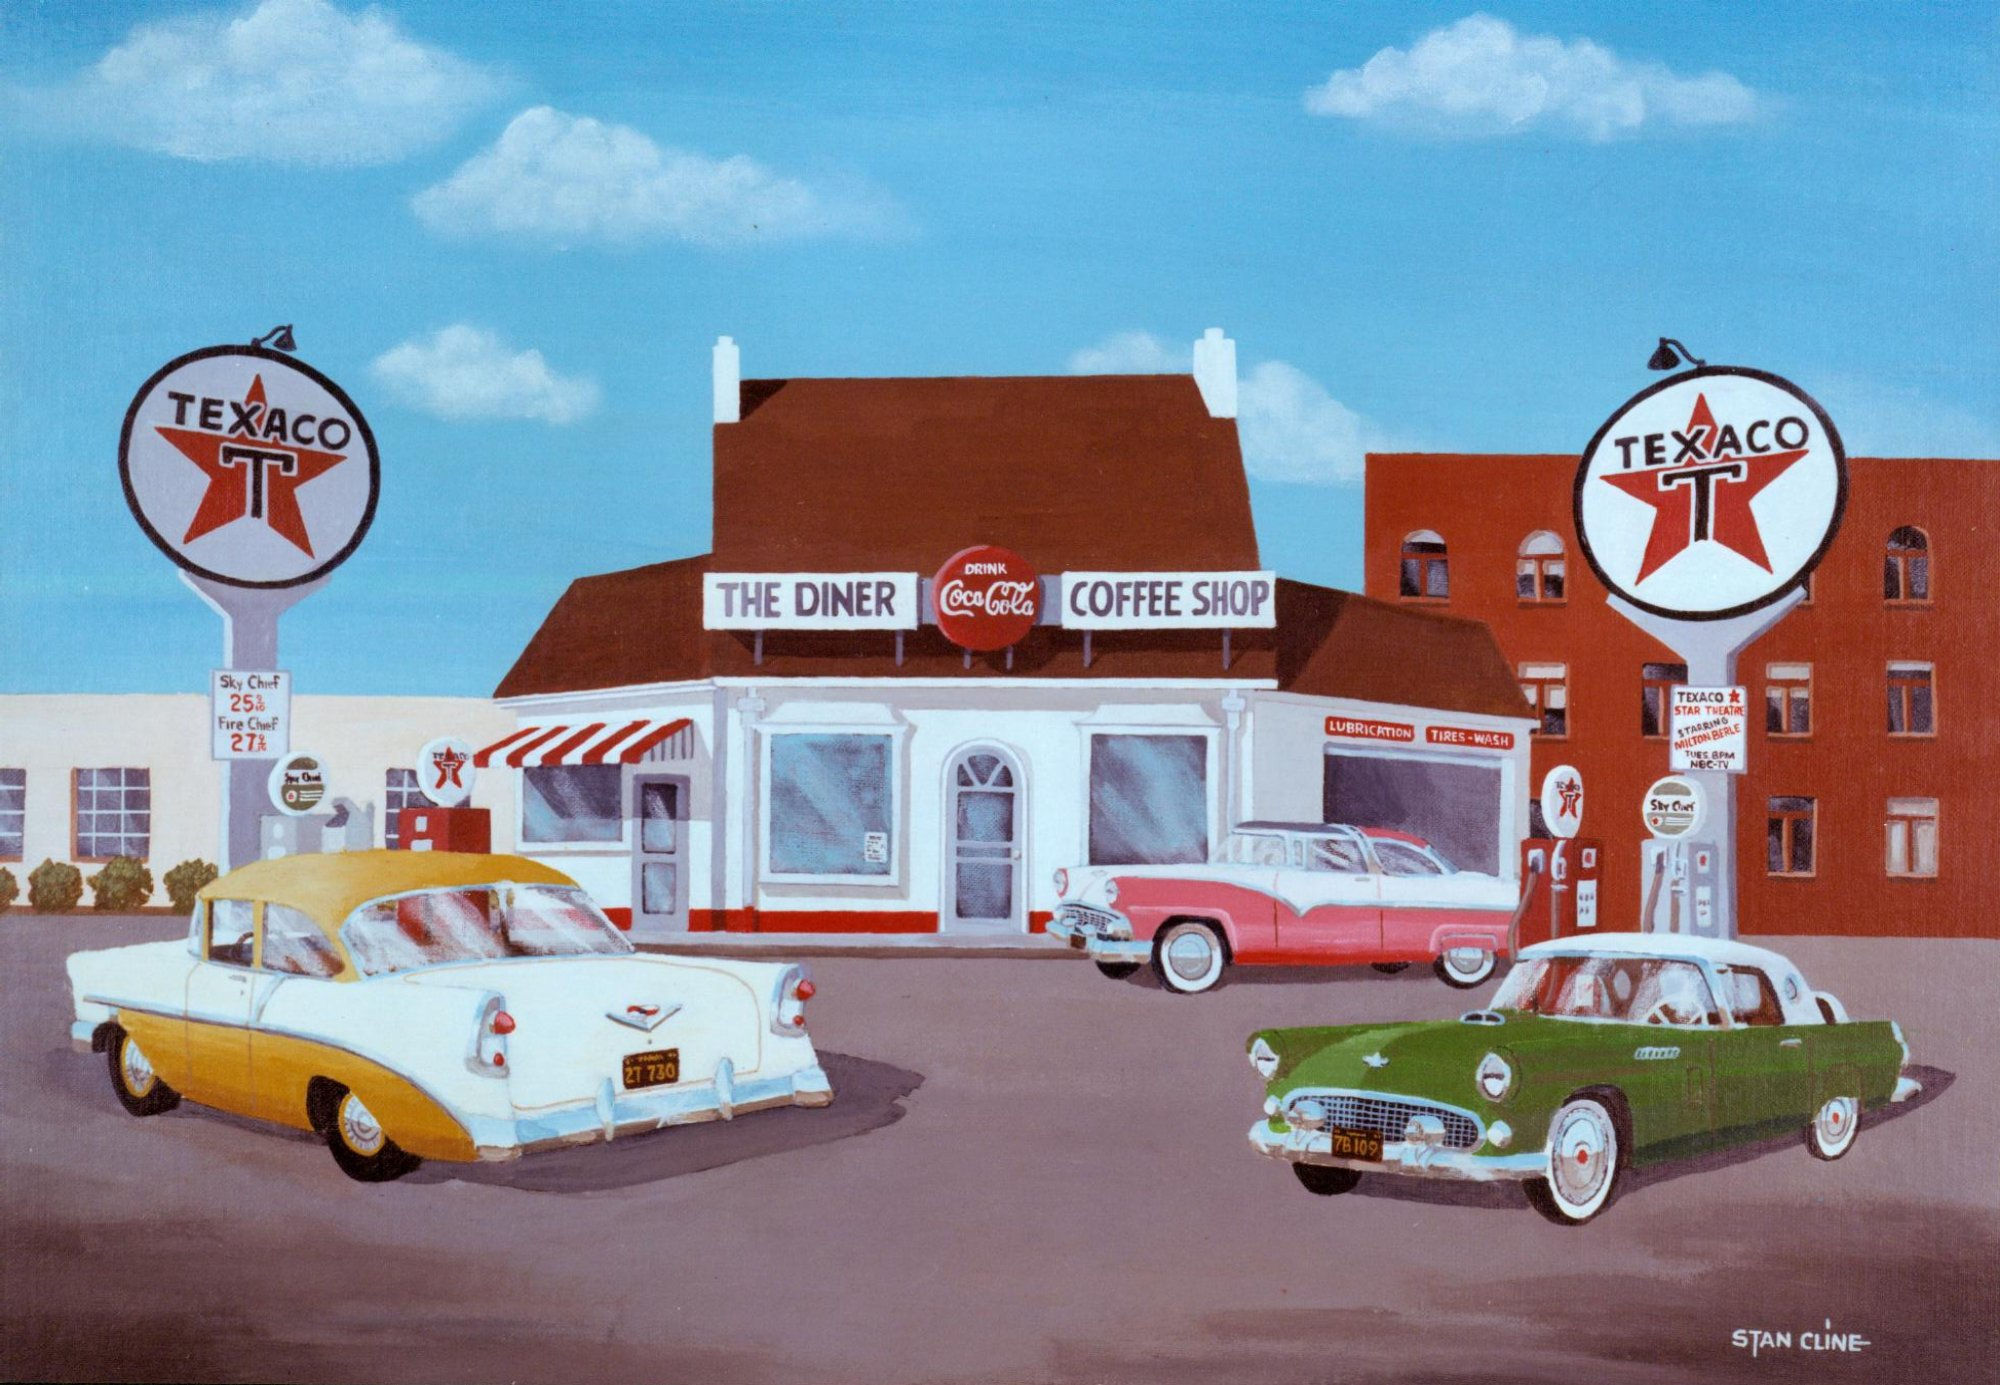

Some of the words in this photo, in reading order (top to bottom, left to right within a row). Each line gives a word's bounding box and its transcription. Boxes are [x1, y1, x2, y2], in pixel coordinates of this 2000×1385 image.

[168, 391, 351, 451] TEXACO
[1614, 416, 1810, 469] TEXACO
[222, 445, 295, 519] T
[1661, 463, 1741, 542] T
[965, 562, 1008, 575] DRINK
[715, 581, 782, 618] THE
[795, 581, 896, 617] DINER
[940, 579, 985, 617] Coca
[985, 581, 1035, 616] Cola
[1070, 580, 1183, 617] COFFEE
[1191, 580, 1270, 617] SHOP
[220, 674, 243, 691] Sky
[248, 674, 280, 689] Chief
[1677, 691, 1724, 703] TEXACO
[1674, 705, 1701, 716] STAR
[1704, 705, 1745, 717] THEATRE
[218, 716, 244, 731] Fire
[247, 716, 279, 731] Chief
[1329, 720, 1412, 739] LUBRICATION
[1677, 716, 1729, 738] STARRING
[1674, 732, 1711, 750] MILTON
[1711, 723, 1742, 741] BERLE
[1690, 760, 1729, 770] NBC-TV
[647, 1063, 676, 1082] 730
[1731, 1328, 1792, 1358] STAN
[1800, 1317, 1872, 1352] CLINE
